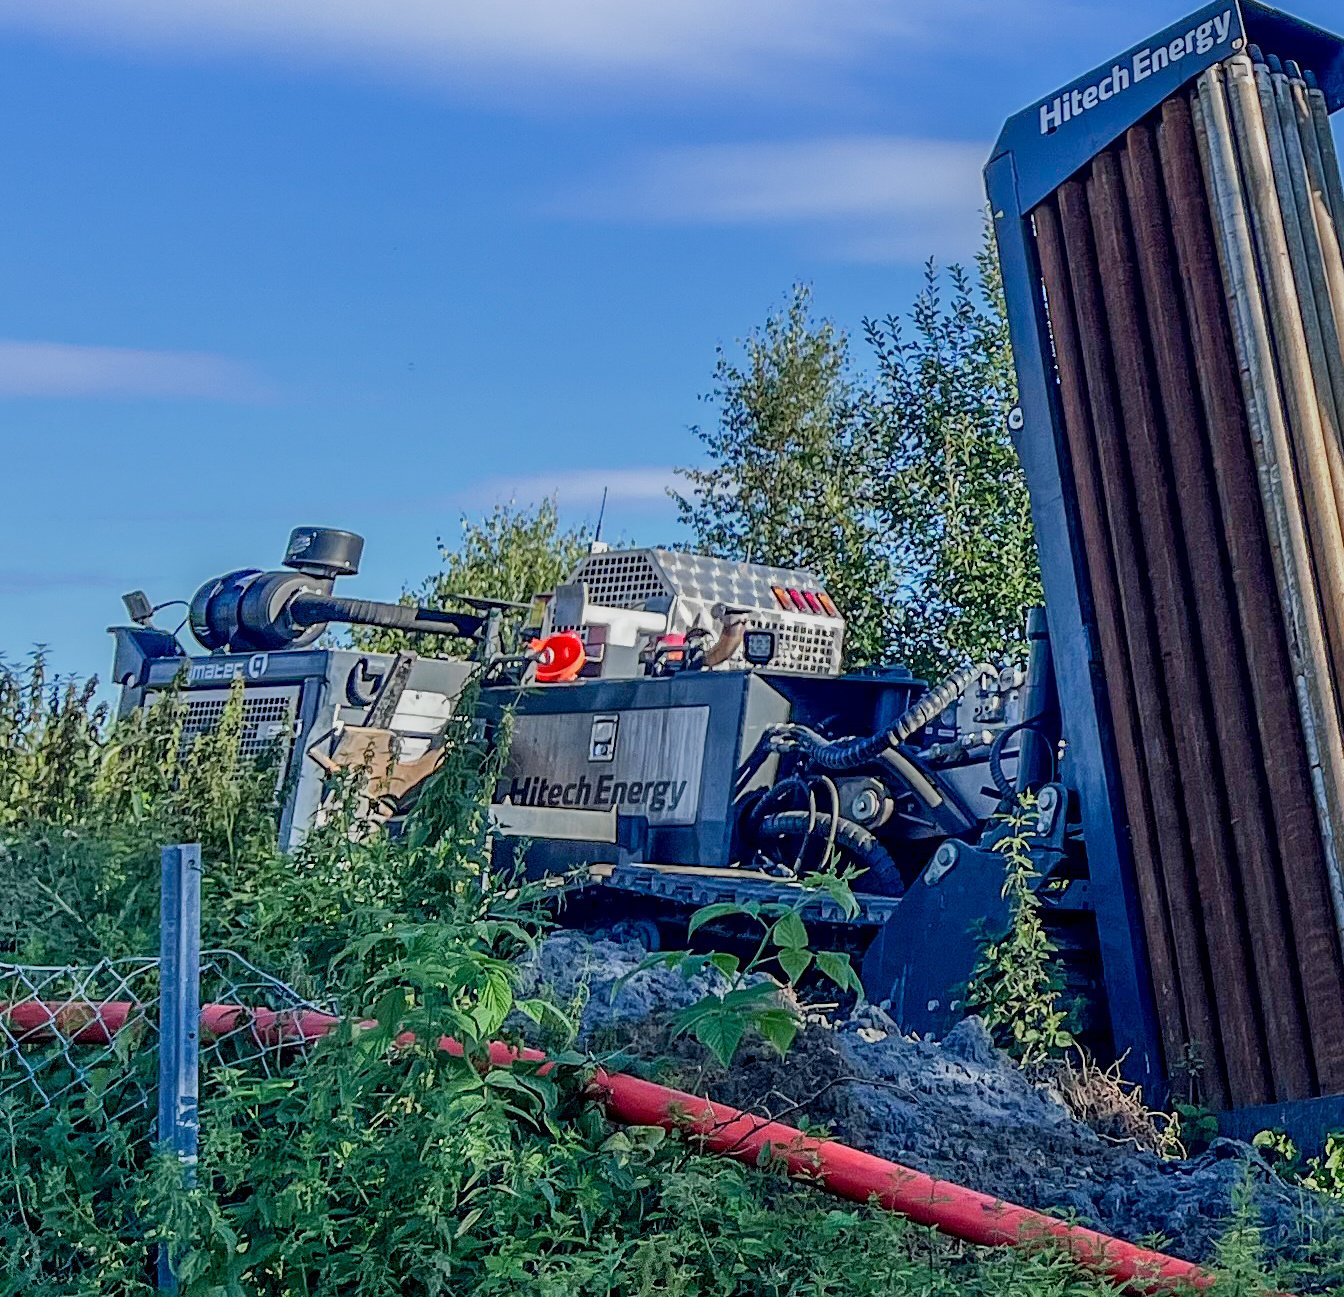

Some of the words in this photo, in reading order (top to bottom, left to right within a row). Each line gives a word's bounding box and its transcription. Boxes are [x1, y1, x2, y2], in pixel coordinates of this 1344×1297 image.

[1039, 64, 1130, 135] Hitech
[1132, 9, 1232, 84] Energy
[510, 774, 592, 806] Hitech
[593, 773, 688, 812] Energy
